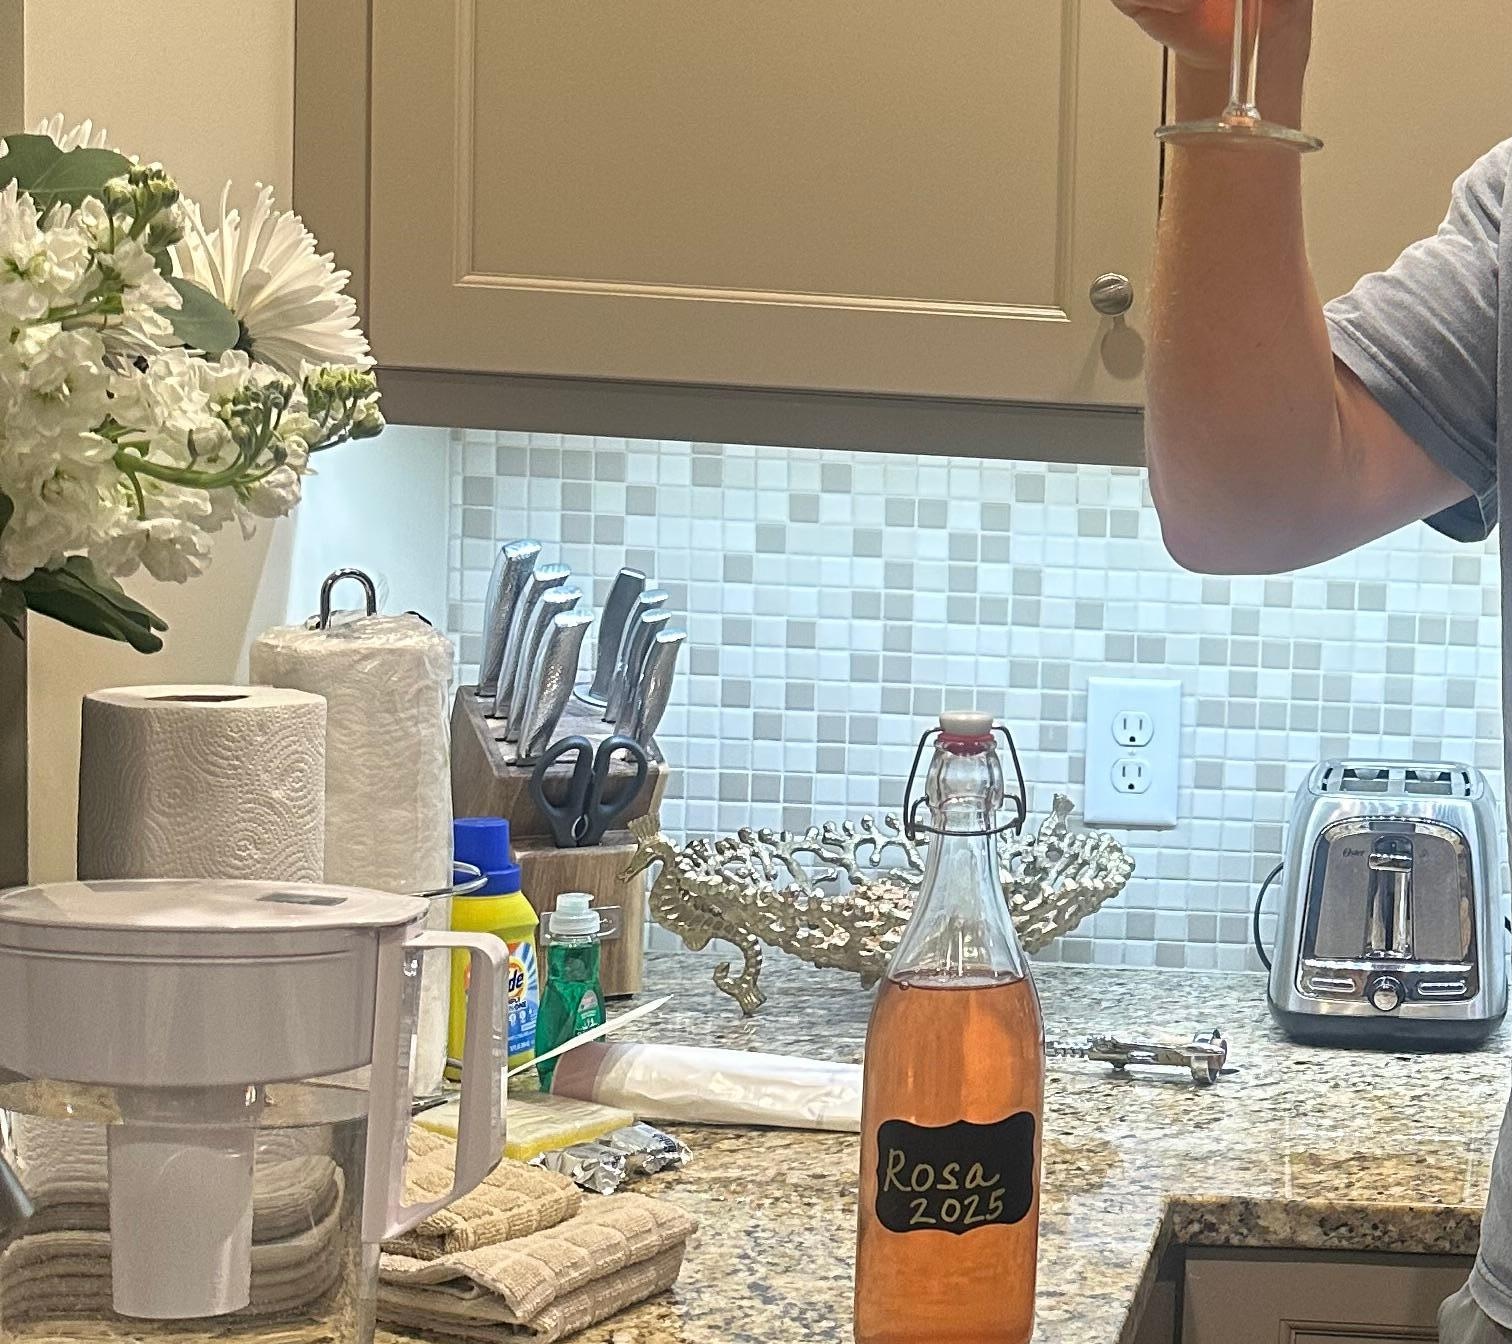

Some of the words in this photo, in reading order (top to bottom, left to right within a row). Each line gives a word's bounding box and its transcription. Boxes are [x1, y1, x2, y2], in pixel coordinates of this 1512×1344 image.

[508, 968, 524, 993] de
[883, 1148, 1001, 1192] Rosa
[909, 1187, 1006, 1225] 2025
